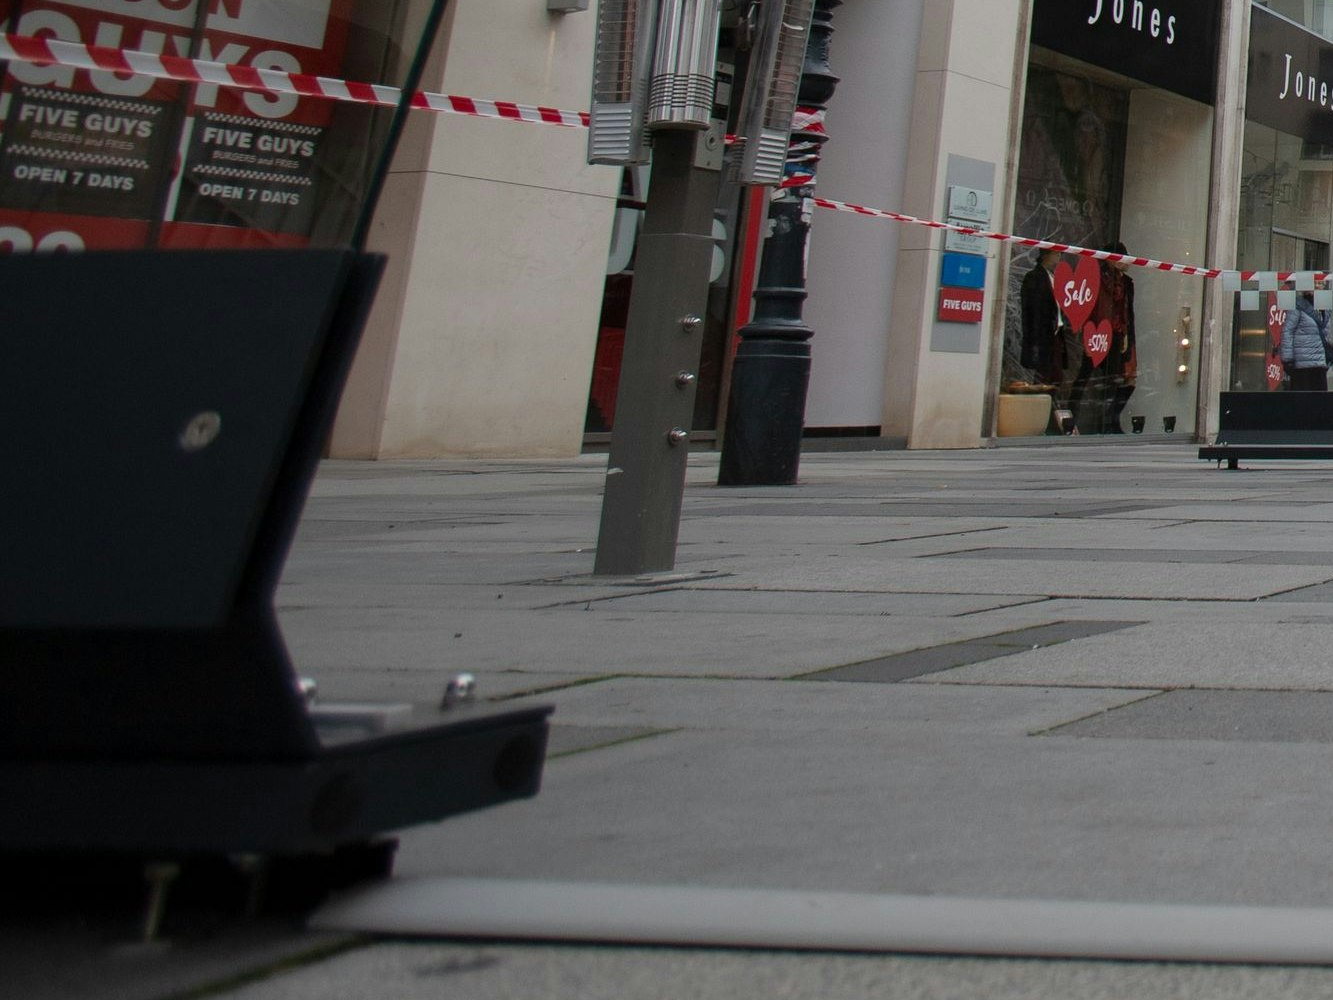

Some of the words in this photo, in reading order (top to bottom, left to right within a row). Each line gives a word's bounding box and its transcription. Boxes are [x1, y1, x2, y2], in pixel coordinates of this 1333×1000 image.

[19, 103, 78, 128] FIVE
[85, 113, 153, 139] GUYS
[30, 129, 82, 146] BURGERS
[84, 137, 104, 148] and
[105, 138, 136, 151] FRIES
[202, 126, 253, 149] FIVE
[257, 133, 315, 158] GUYS
[212, 150, 257, 164] BURGERS
[257, 156, 274, 166] and
[275, 157, 300, 170] FRIES
[14, 164, 66, 184] OPEN
[72, 170, 85, 185] 7
[87, 172, 135, 191] DAYS
[199, 182, 244, 201] OPEN
[247, 187, 257, 201] 7
[260, 188, 301, 206] DAYS
[1063, 278, 1093, 308] Sale
[943, 299, 961, 311] FIVE
[961, 300, 982, 312] GUYS
[1088, 333, 1109, 352] -50%
